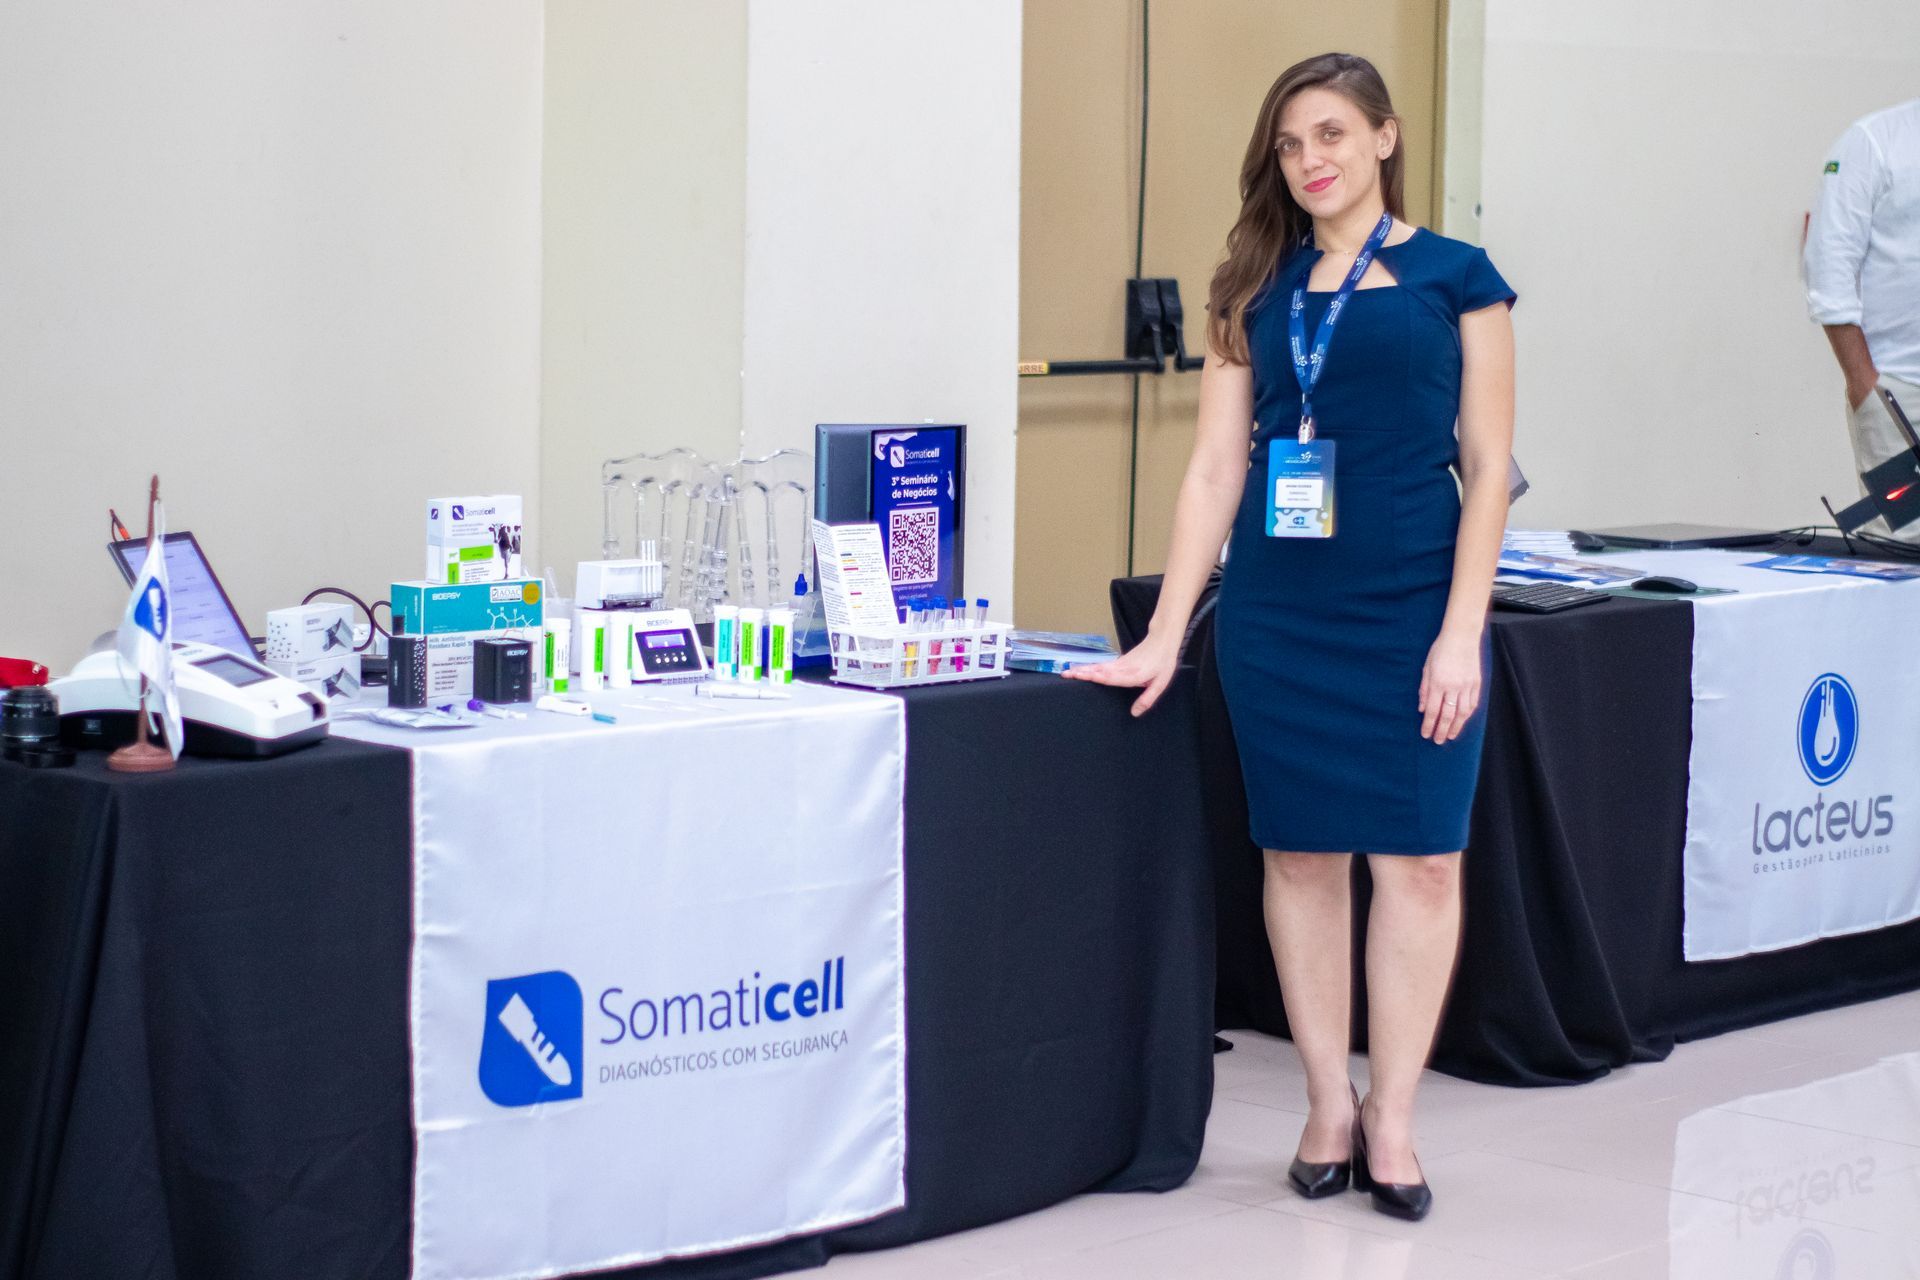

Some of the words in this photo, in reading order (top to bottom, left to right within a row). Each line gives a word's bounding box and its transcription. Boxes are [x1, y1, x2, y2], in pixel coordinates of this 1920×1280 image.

[905, 447, 940, 460] Somaticell
[891, 489, 902, 499] de
[903, 487, 938, 500] Negócios
[900, 474, 938, 486] Seminário
[1753, 792, 1894, 855] lacteus
[1753, 858, 1801, 874] Gestão
[1803, 852, 1824, 867] para
[1828, 844, 1891, 861] Laticínios
[599, 956, 844, 1046] Somaticell
[600, 1050, 717, 1084] DIAGNÓSTICOS
[722, 1048, 757, 1068] COM
[762, 1029, 849, 1062] SEGURANÇA
